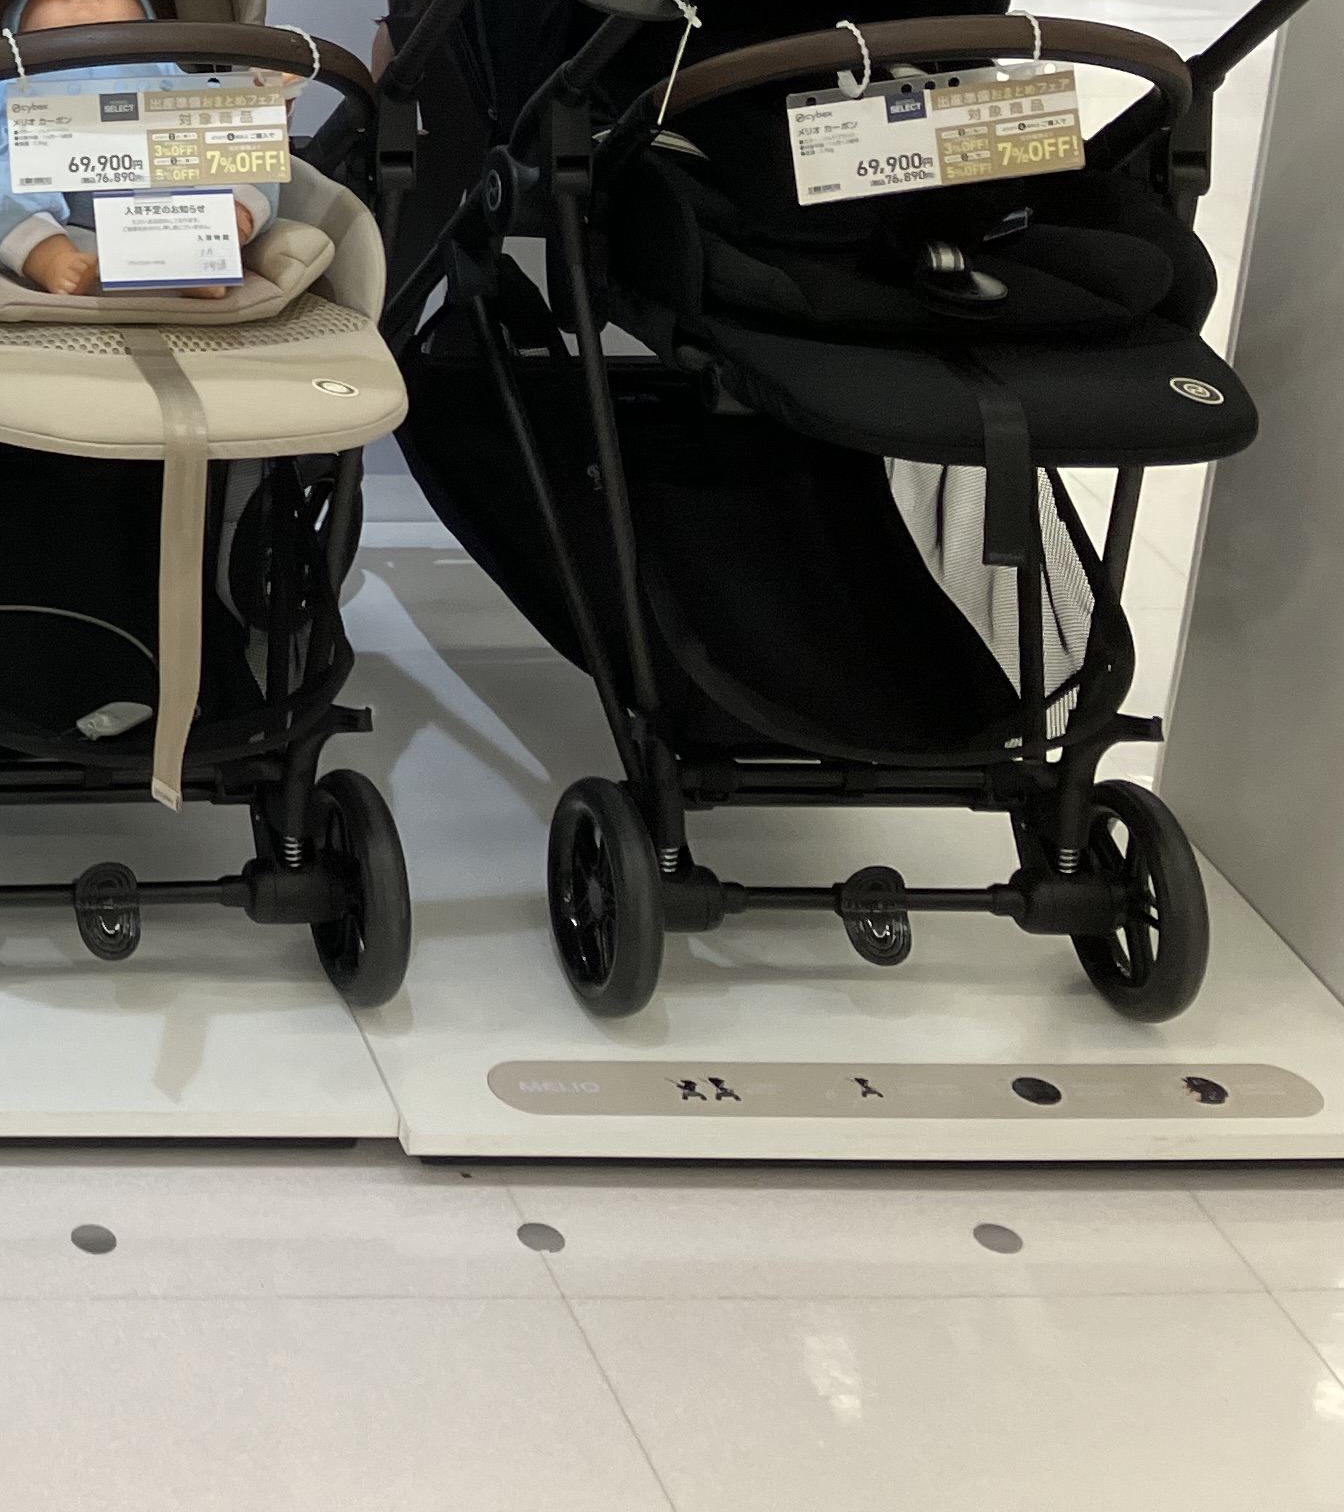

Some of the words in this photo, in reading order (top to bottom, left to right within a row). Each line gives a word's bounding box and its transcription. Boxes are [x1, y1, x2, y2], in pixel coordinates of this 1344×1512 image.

[21, 102, 48, 112] cybex
[103, 104, 135, 113] SELECT
[150, 94, 281, 110] 出産準備おまとめフェア
[997, 135, 1079, 167] 7%OFF!
[68, 154, 143, 173] 69,900円
[206, 151, 285, 174] 7%OFF!
[856, 153, 933, 178] 69,900円
